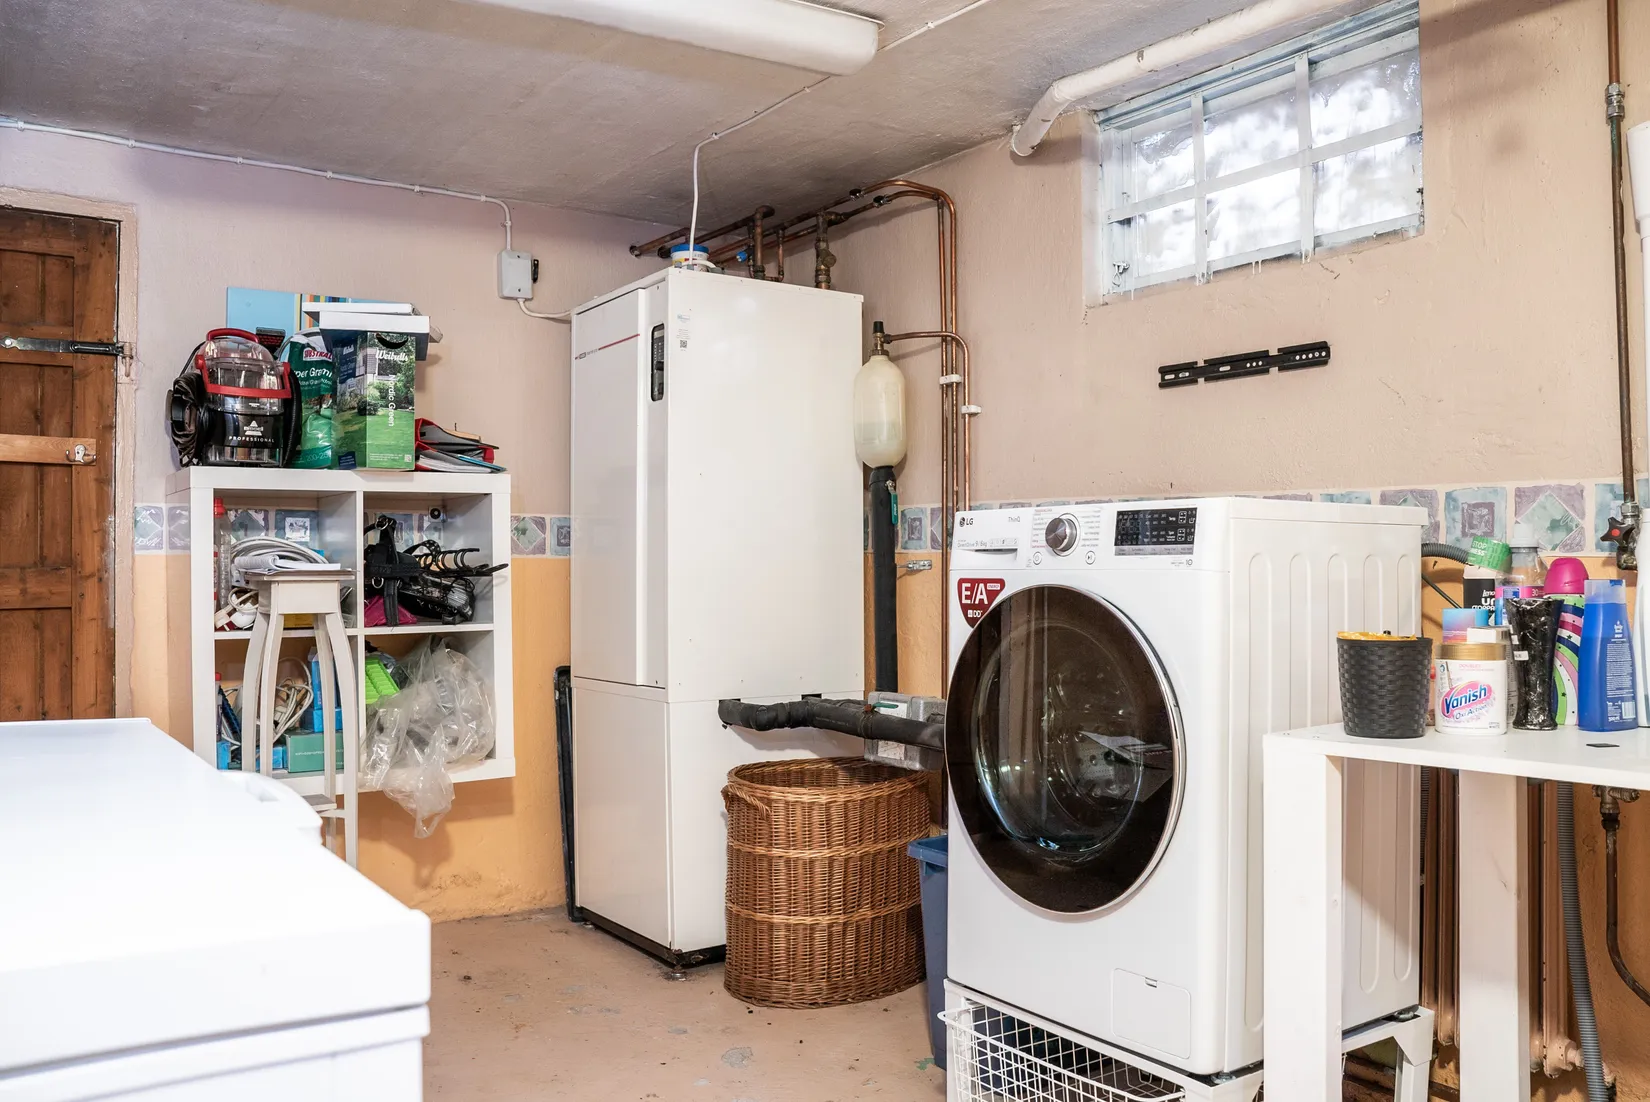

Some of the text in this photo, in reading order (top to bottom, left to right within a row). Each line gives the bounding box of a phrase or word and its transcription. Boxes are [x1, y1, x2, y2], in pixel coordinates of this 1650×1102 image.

[304, 349, 332, 360] SUBSTRAL
[375, 350, 409, 362] Weibulls
[294, 370, 309, 378] per
[388, 375, 396, 427] Nordic Green
[228, 436, 275, 444] PROFESSIONAL
[966, 518, 974, 526] LG
[1472, 540, 1488, 549] STOP
[961, 582, 988, 605] E/A
[1531, 589, 1538, 597] 30
[1444, 684, 1487, 714] Vanish
